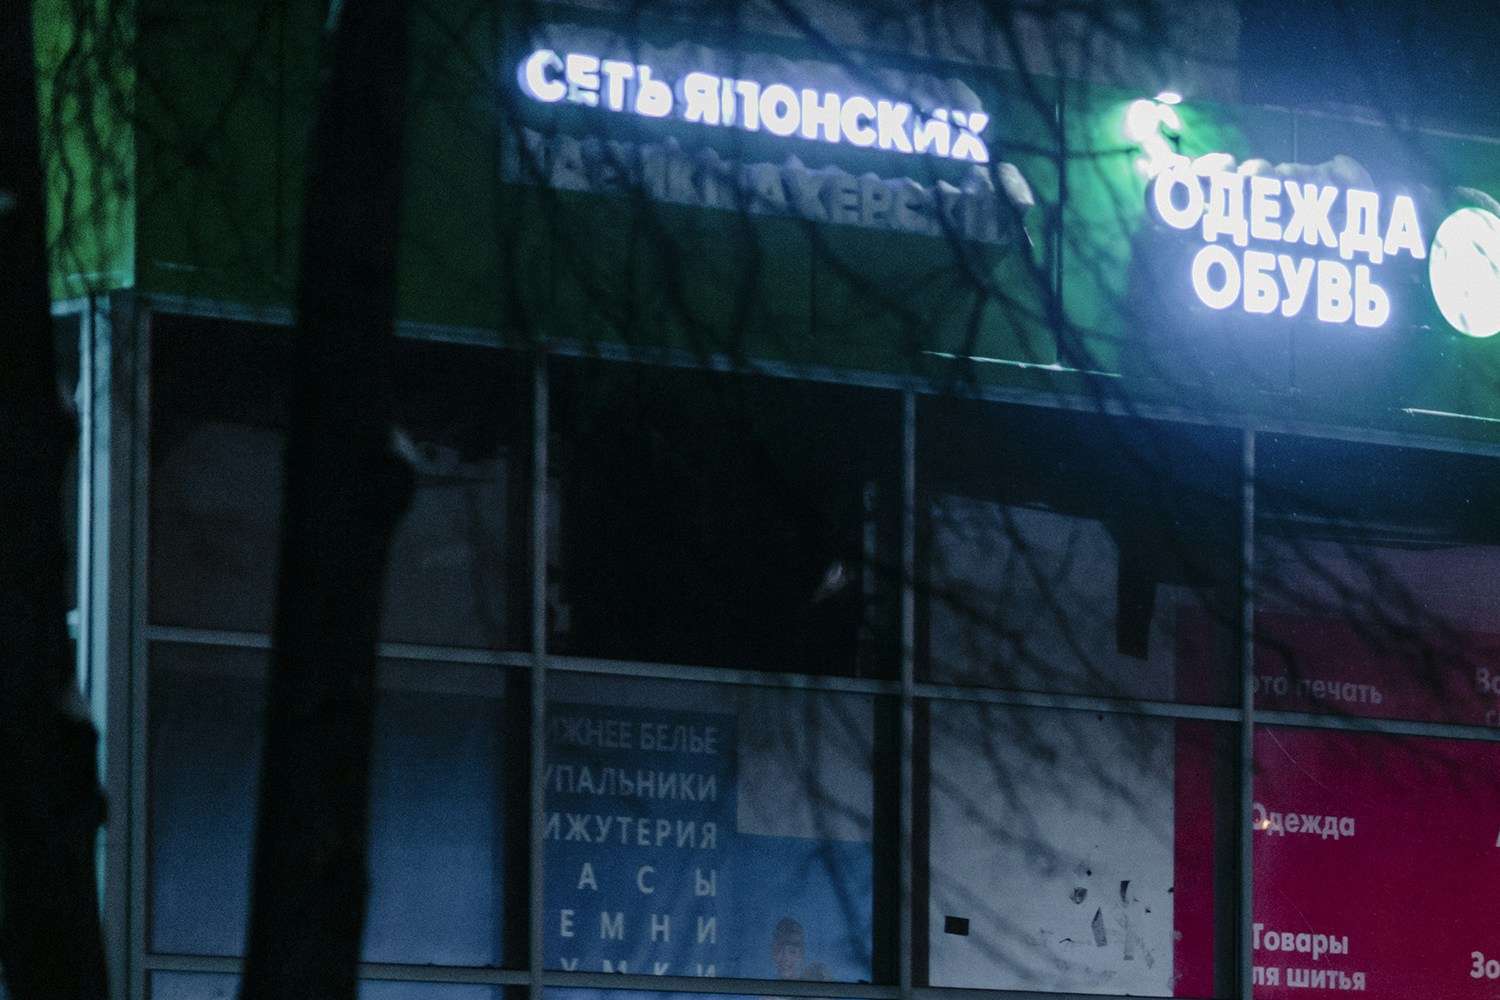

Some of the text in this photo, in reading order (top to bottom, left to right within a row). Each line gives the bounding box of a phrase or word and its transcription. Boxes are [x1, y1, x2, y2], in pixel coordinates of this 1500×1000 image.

[522, 48, 992, 164] СЕТЬ ЯПОНСКИХ
[1154, 168, 1428, 264] ОДЕЖДА
[1192, 244, 1391, 329] ОБУВЬ
[1250, 670, 1288, 697] ото
[543, 812, 717, 849] ИЖУТЕРИЯ
[1251, 804, 1356, 841] Одежда
[1251, 922, 1350, 961] Товары
[1286, 967, 1367, 992] шитья
